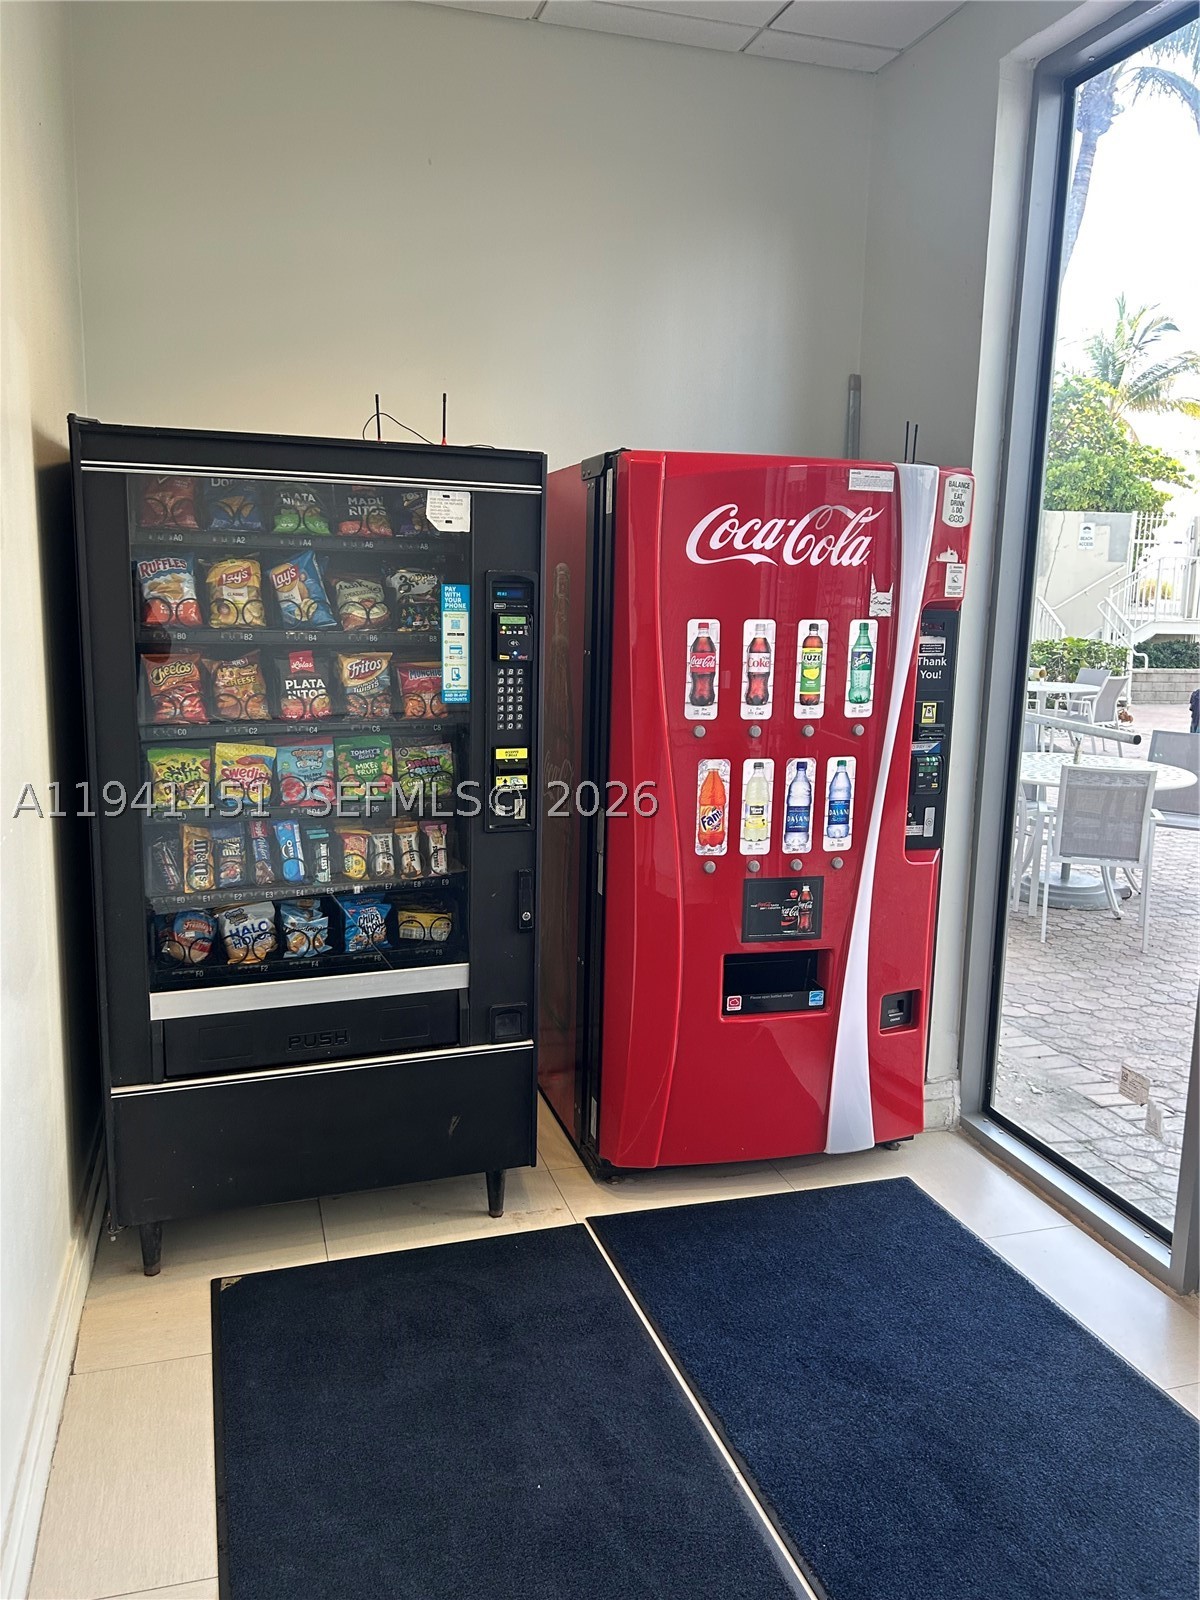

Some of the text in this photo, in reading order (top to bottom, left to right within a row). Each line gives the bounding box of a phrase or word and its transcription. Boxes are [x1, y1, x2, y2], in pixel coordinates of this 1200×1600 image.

[949, 481, 970, 489] BALANCE
[173, 534, 183, 542] A0
[236, 536, 246, 544] A2
[685, 503, 886, 567] Coca-Cola
[302, 539, 312, 547] A4
[139, 557, 187, 578] RUFFLES
[222, 568, 250, 585] Lay's
[272, 567, 297, 589] Lay's
[690, 656, 716, 668] Coca-Cola
[748, 657, 770, 668] Coke
[918, 657, 947, 666] Thank
[151, 660, 194, 686] Cheetos
[347, 659, 382, 679] Fritos
[409, 668, 442, 681] MUNCHI
[920, 670, 942, 679] You!
[225, 675, 256, 687] CHEESE
[285, 679, 326, 690] PLATA
[309, 726, 318, 734] C4
[350, 748, 380, 756] TOMMY'S
[164, 769, 200, 782] SOUR
[221, 767, 271, 784] Swedish
[358, 913, 380, 927] Chips
[229, 920, 270, 938] HALO
[288, 1030, 349, 1050] PUSH
